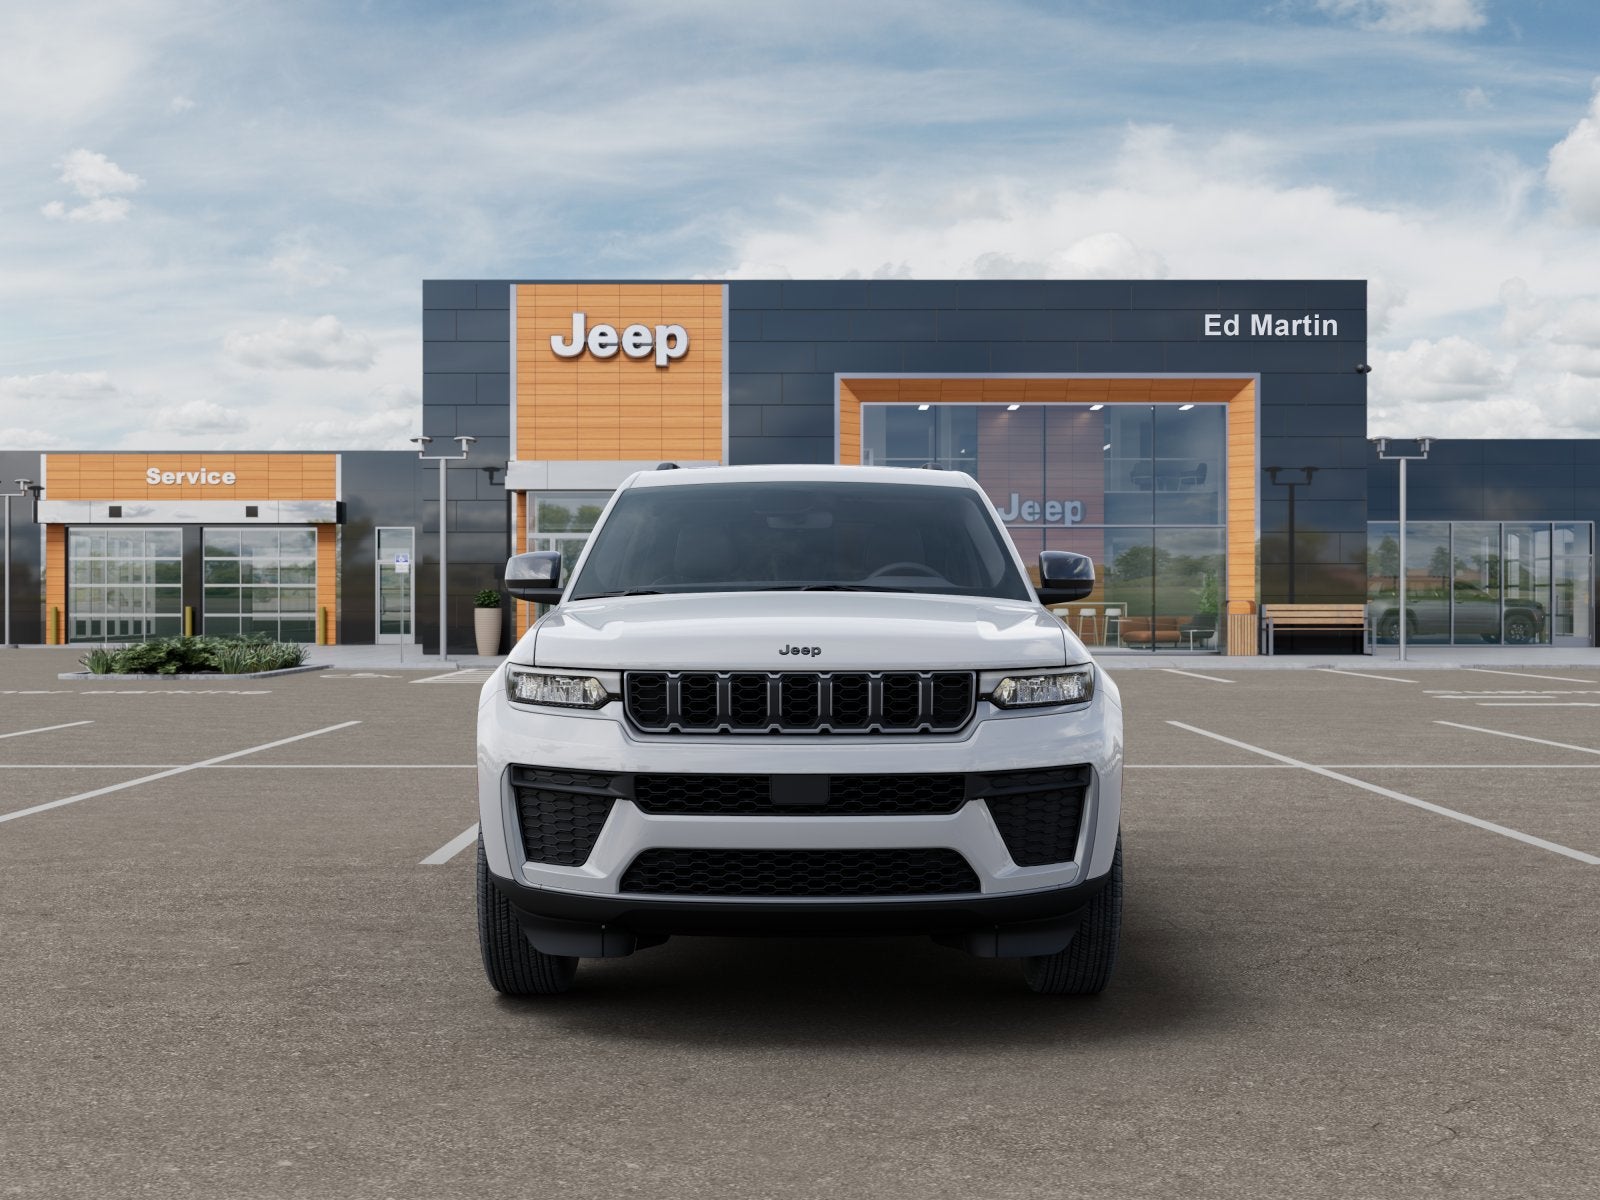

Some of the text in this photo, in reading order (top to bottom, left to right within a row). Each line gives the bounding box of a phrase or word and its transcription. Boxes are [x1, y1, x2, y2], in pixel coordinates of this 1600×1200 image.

[1204, 314, 1338, 336] Ed Martin
[550, 312, 689, 367] Jeep
[146, 467, 236, 485] Service
[997, 493, 1084, 527] Jeep
[778, 644, 822, 657] Jeep
